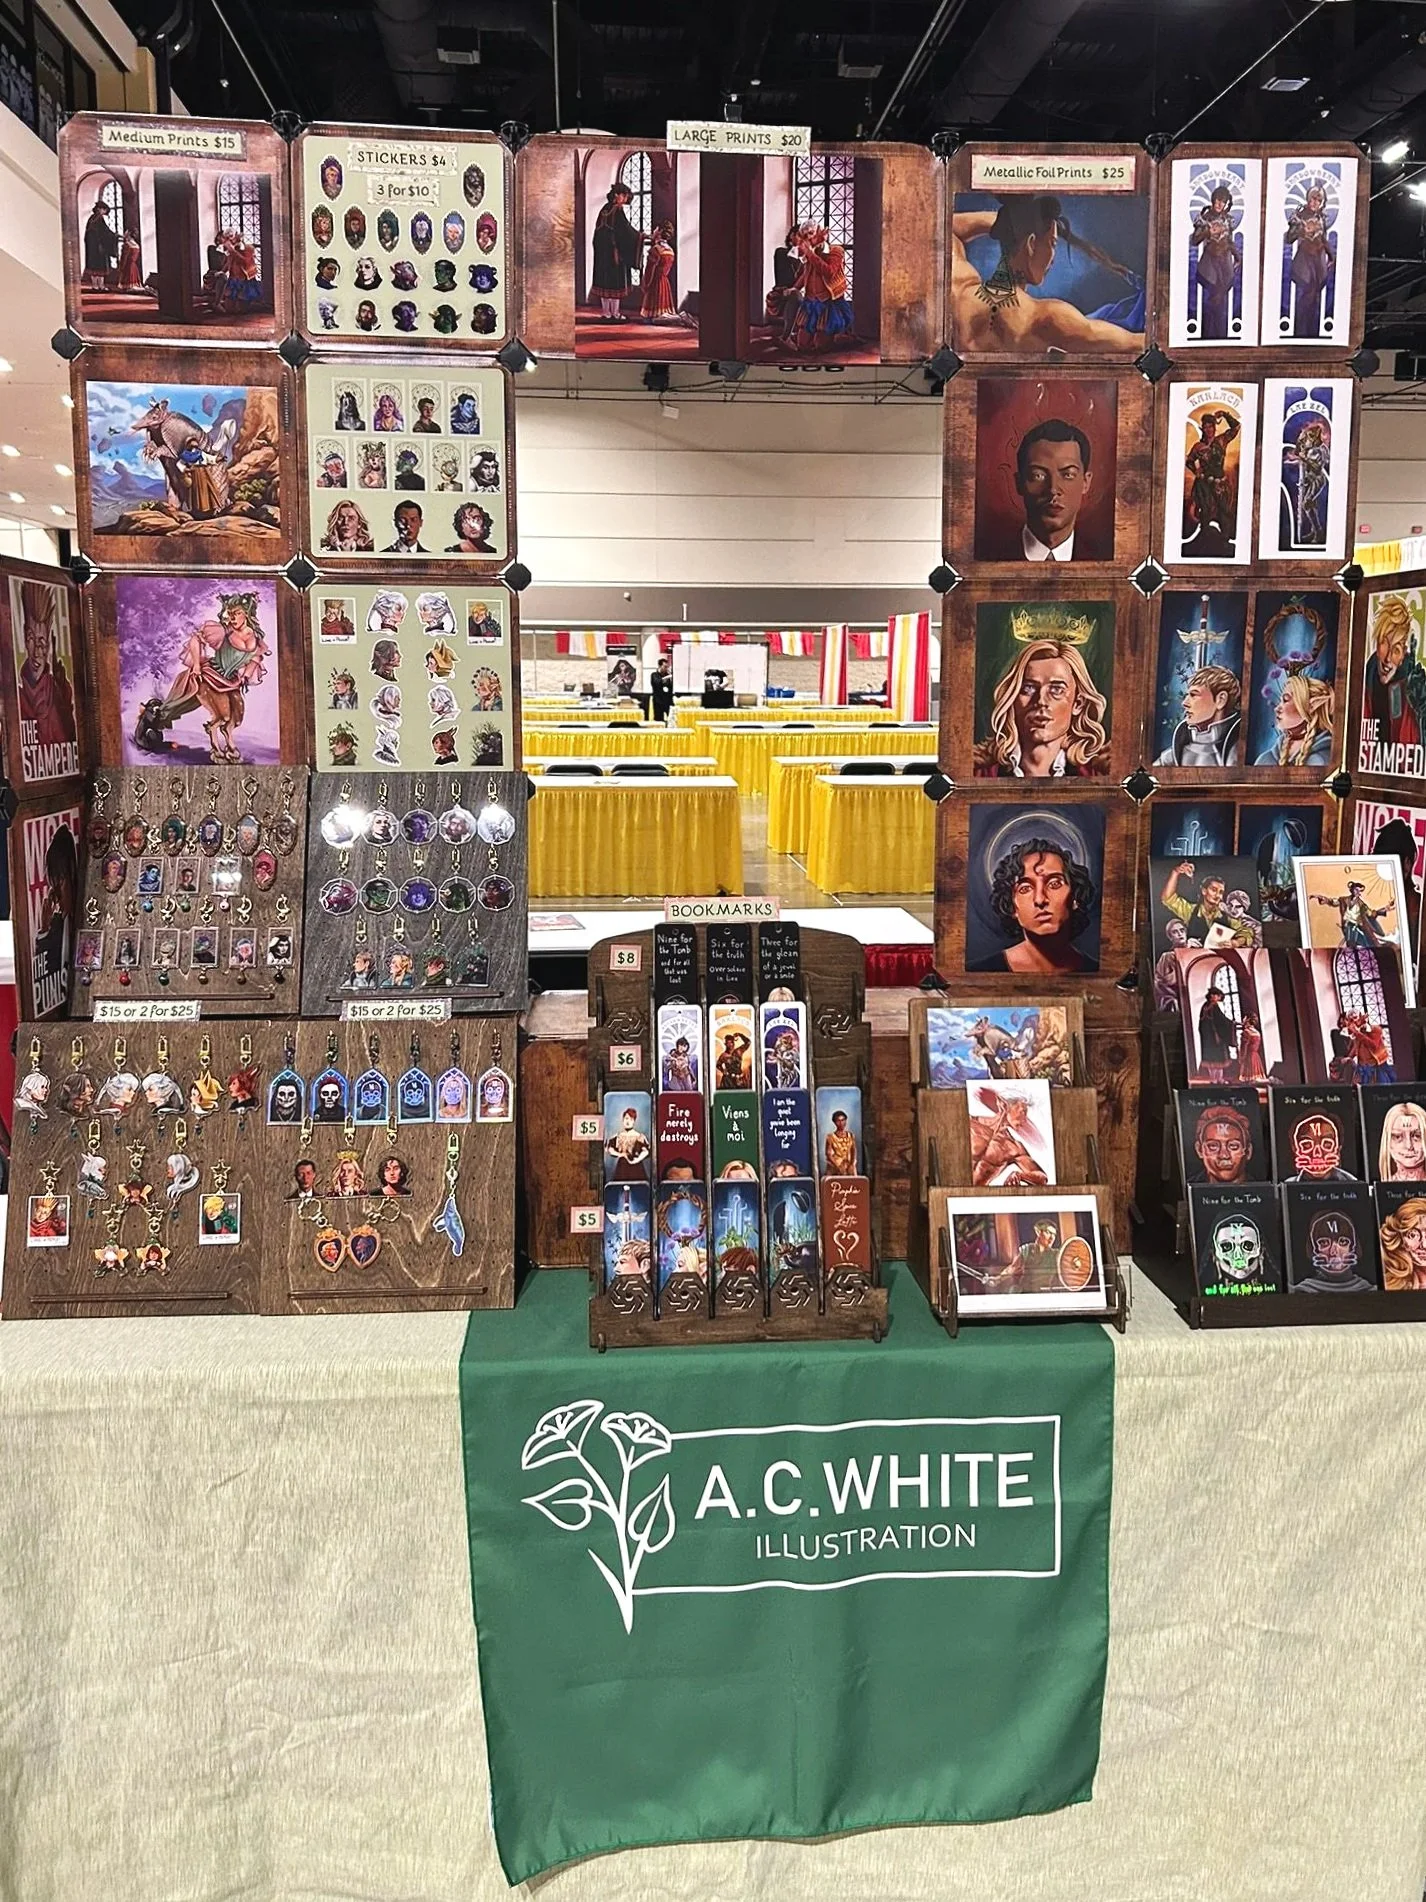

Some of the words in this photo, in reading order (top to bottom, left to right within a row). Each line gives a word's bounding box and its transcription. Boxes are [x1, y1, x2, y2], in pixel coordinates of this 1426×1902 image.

[109, 130, 164, 144] Medium
[168, 134, 208, 147] Prints
[214, 136, 235, 149] $15
[674, 130, 716, 144] LARGE
[726, 132, 771, 144] PRINTS
[782, 134, 802, 146] $20
[358, 151, 426, 166] STICKERS
[432, 155, 446, 166] $4
[984, 166, 1034, 178] Metallic
[1036, 166, 1056, 178] Foil
[1058, 166, 1092, 178] Prints
[1102, 167, 1124, 179] $25
[377, 184, 384, 195] 3
[388, 183, 406, 198] for
[408, 185, 430, 197] $10
[21, 719, 38, 745] THE
[1361, 718, 1380, 742] THE
[671, 903, 772, 917] BOOKMARKS
[657, 934, 678, 944] Nine
[680, 932, 693, 944] for
[712, 938, 726, 948] Six
[731, 938, 744, 948] for
[760, 936, 782, 946] Three
[785, 936, 798, 946] for
[618, 952, 635, 964] $8
[712, 950, 723, 958] the
[726, 950, 744, 958] truth
[761, 948, 772, 958] the
[33, 950, 48, 980] THE
[100, 1005, 121, 1017] $15
[124, 1008, 136, 1017] or
[140, 1006, 148, 1016] 2
[150, 1004, 169, 1018] for
[170, 1004, 194, 1016] $25
[350, 1005, 368, 1017] $15
[372, 1008, 385, 1016] or
[387, 1006, 394, 1016] 2
[398, 1004, 416, 1018] for
[419, 1004, 442, 1016] $25
[618, 1052, 634, 1066] $6
[668, 1103, 690, 1118] Fire
[722, 1104, 750, 1120] Viens
[580, 1120, 597, 1135] $5
[660, 1130, 698, 1146] destroys
[726, 1130, 745, 1142] moi
[578, 1213, 597, 1227] $5
[756, 1523, 976, 1561] ILLUSTRATION
